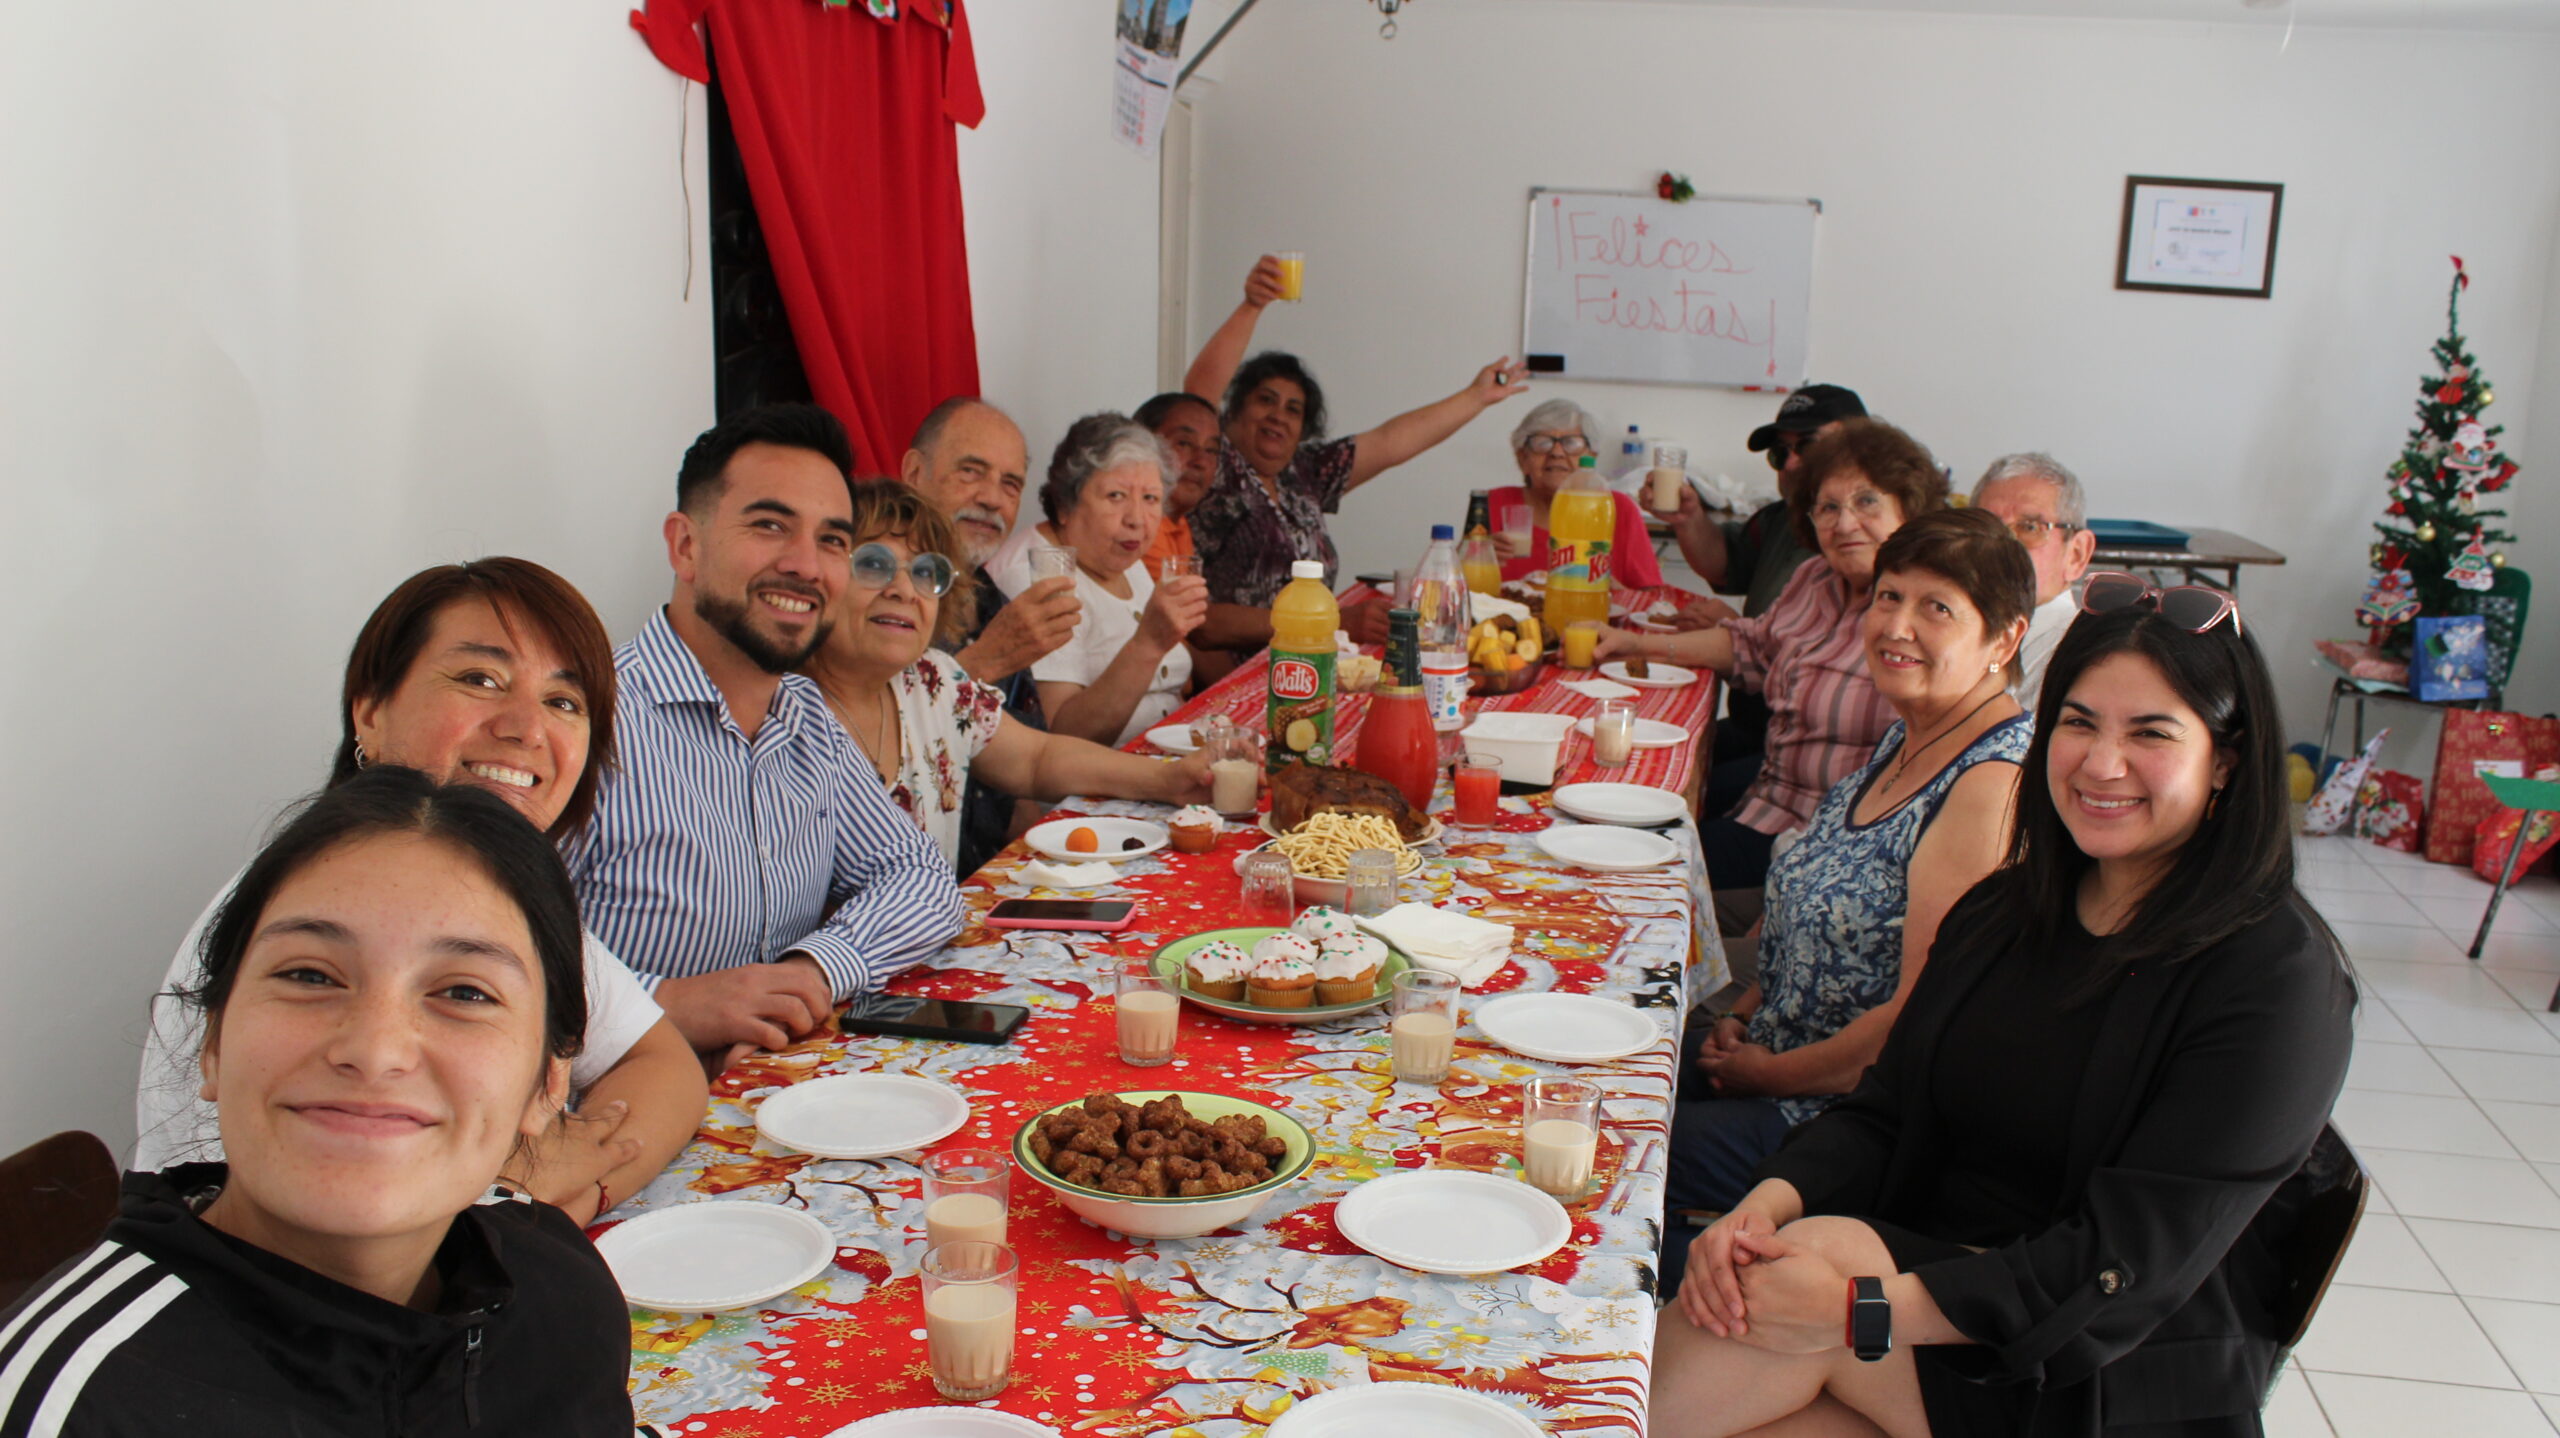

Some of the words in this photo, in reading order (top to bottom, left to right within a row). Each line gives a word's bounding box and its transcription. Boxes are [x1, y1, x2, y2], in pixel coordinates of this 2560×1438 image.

[1552, 197, 1753, 274] ¡Felices
[1574, 274, 1777, 377] Fiestas!
[1551, 543, 1576, 569] em
